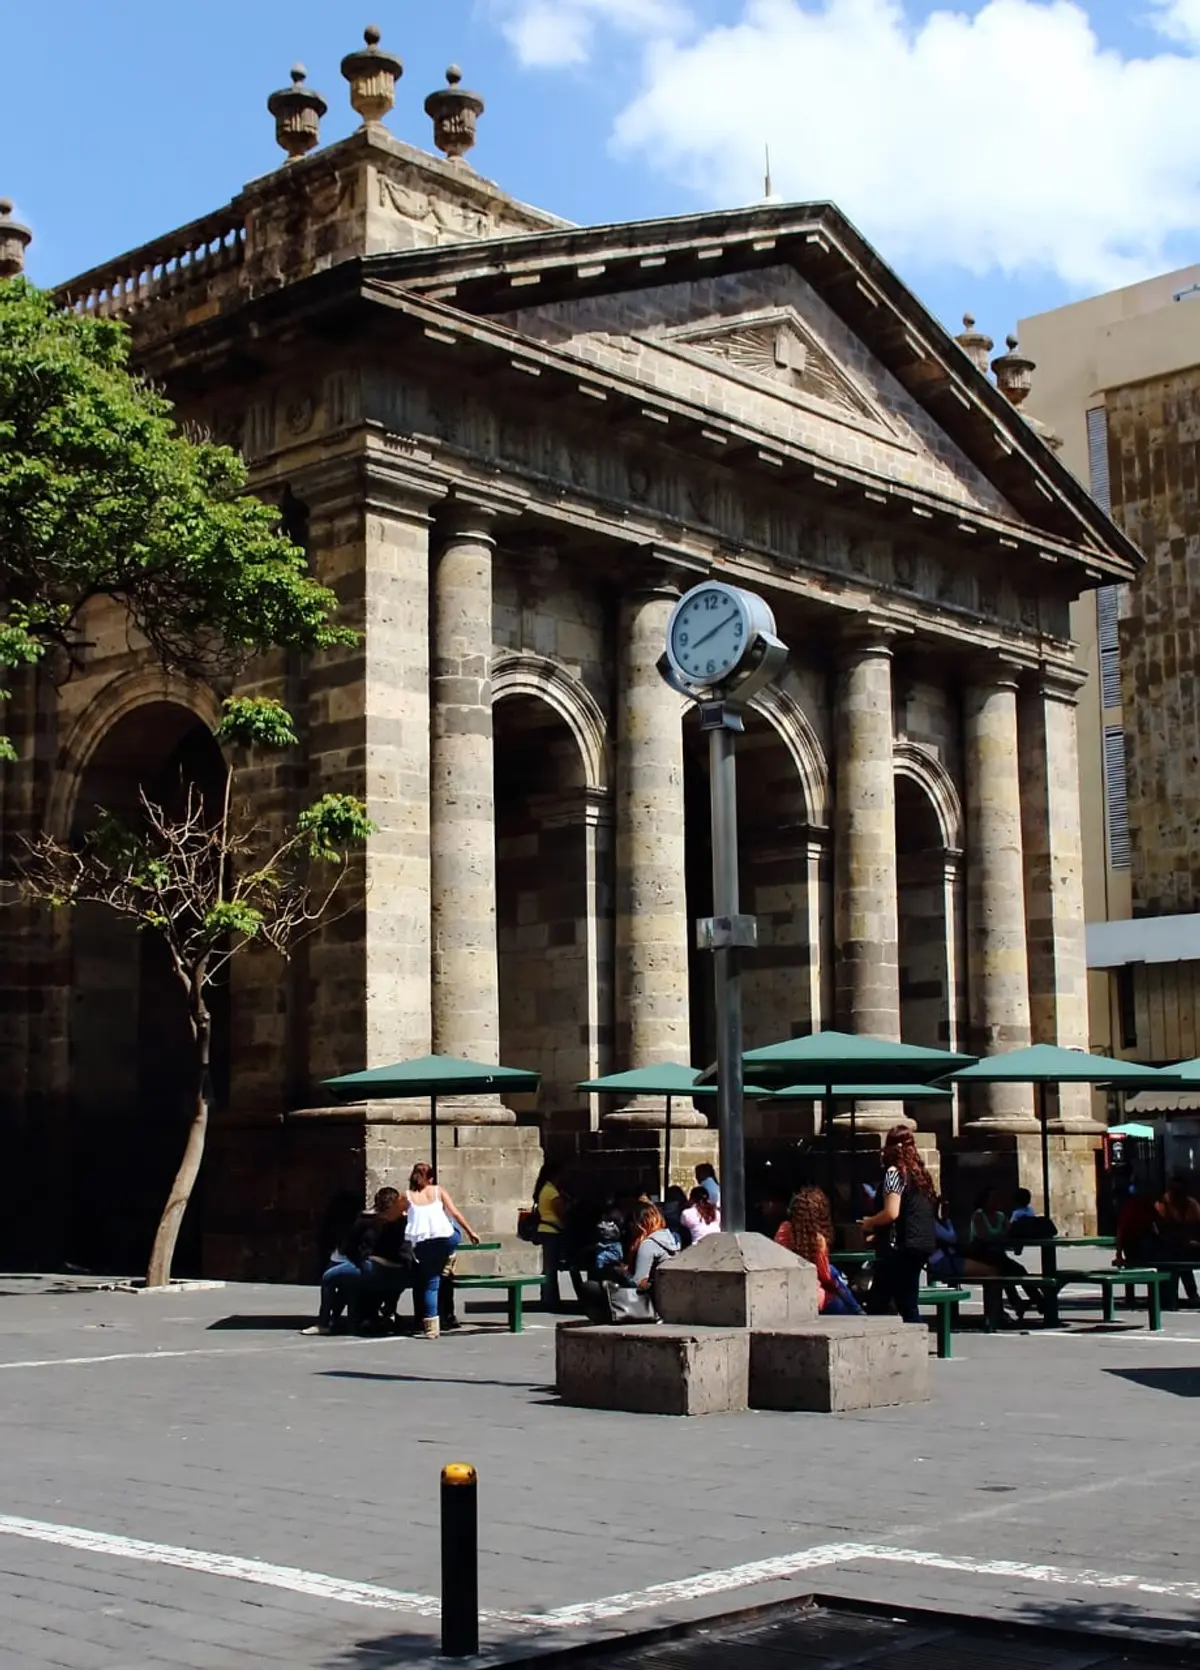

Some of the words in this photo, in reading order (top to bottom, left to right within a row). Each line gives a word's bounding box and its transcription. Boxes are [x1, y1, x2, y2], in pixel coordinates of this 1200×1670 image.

[704, 595, 719, 610] 12
[734, 622, 743, 637] 3
[679, 632, 688, 647] 9
[706, 659, 716, 674] 6
